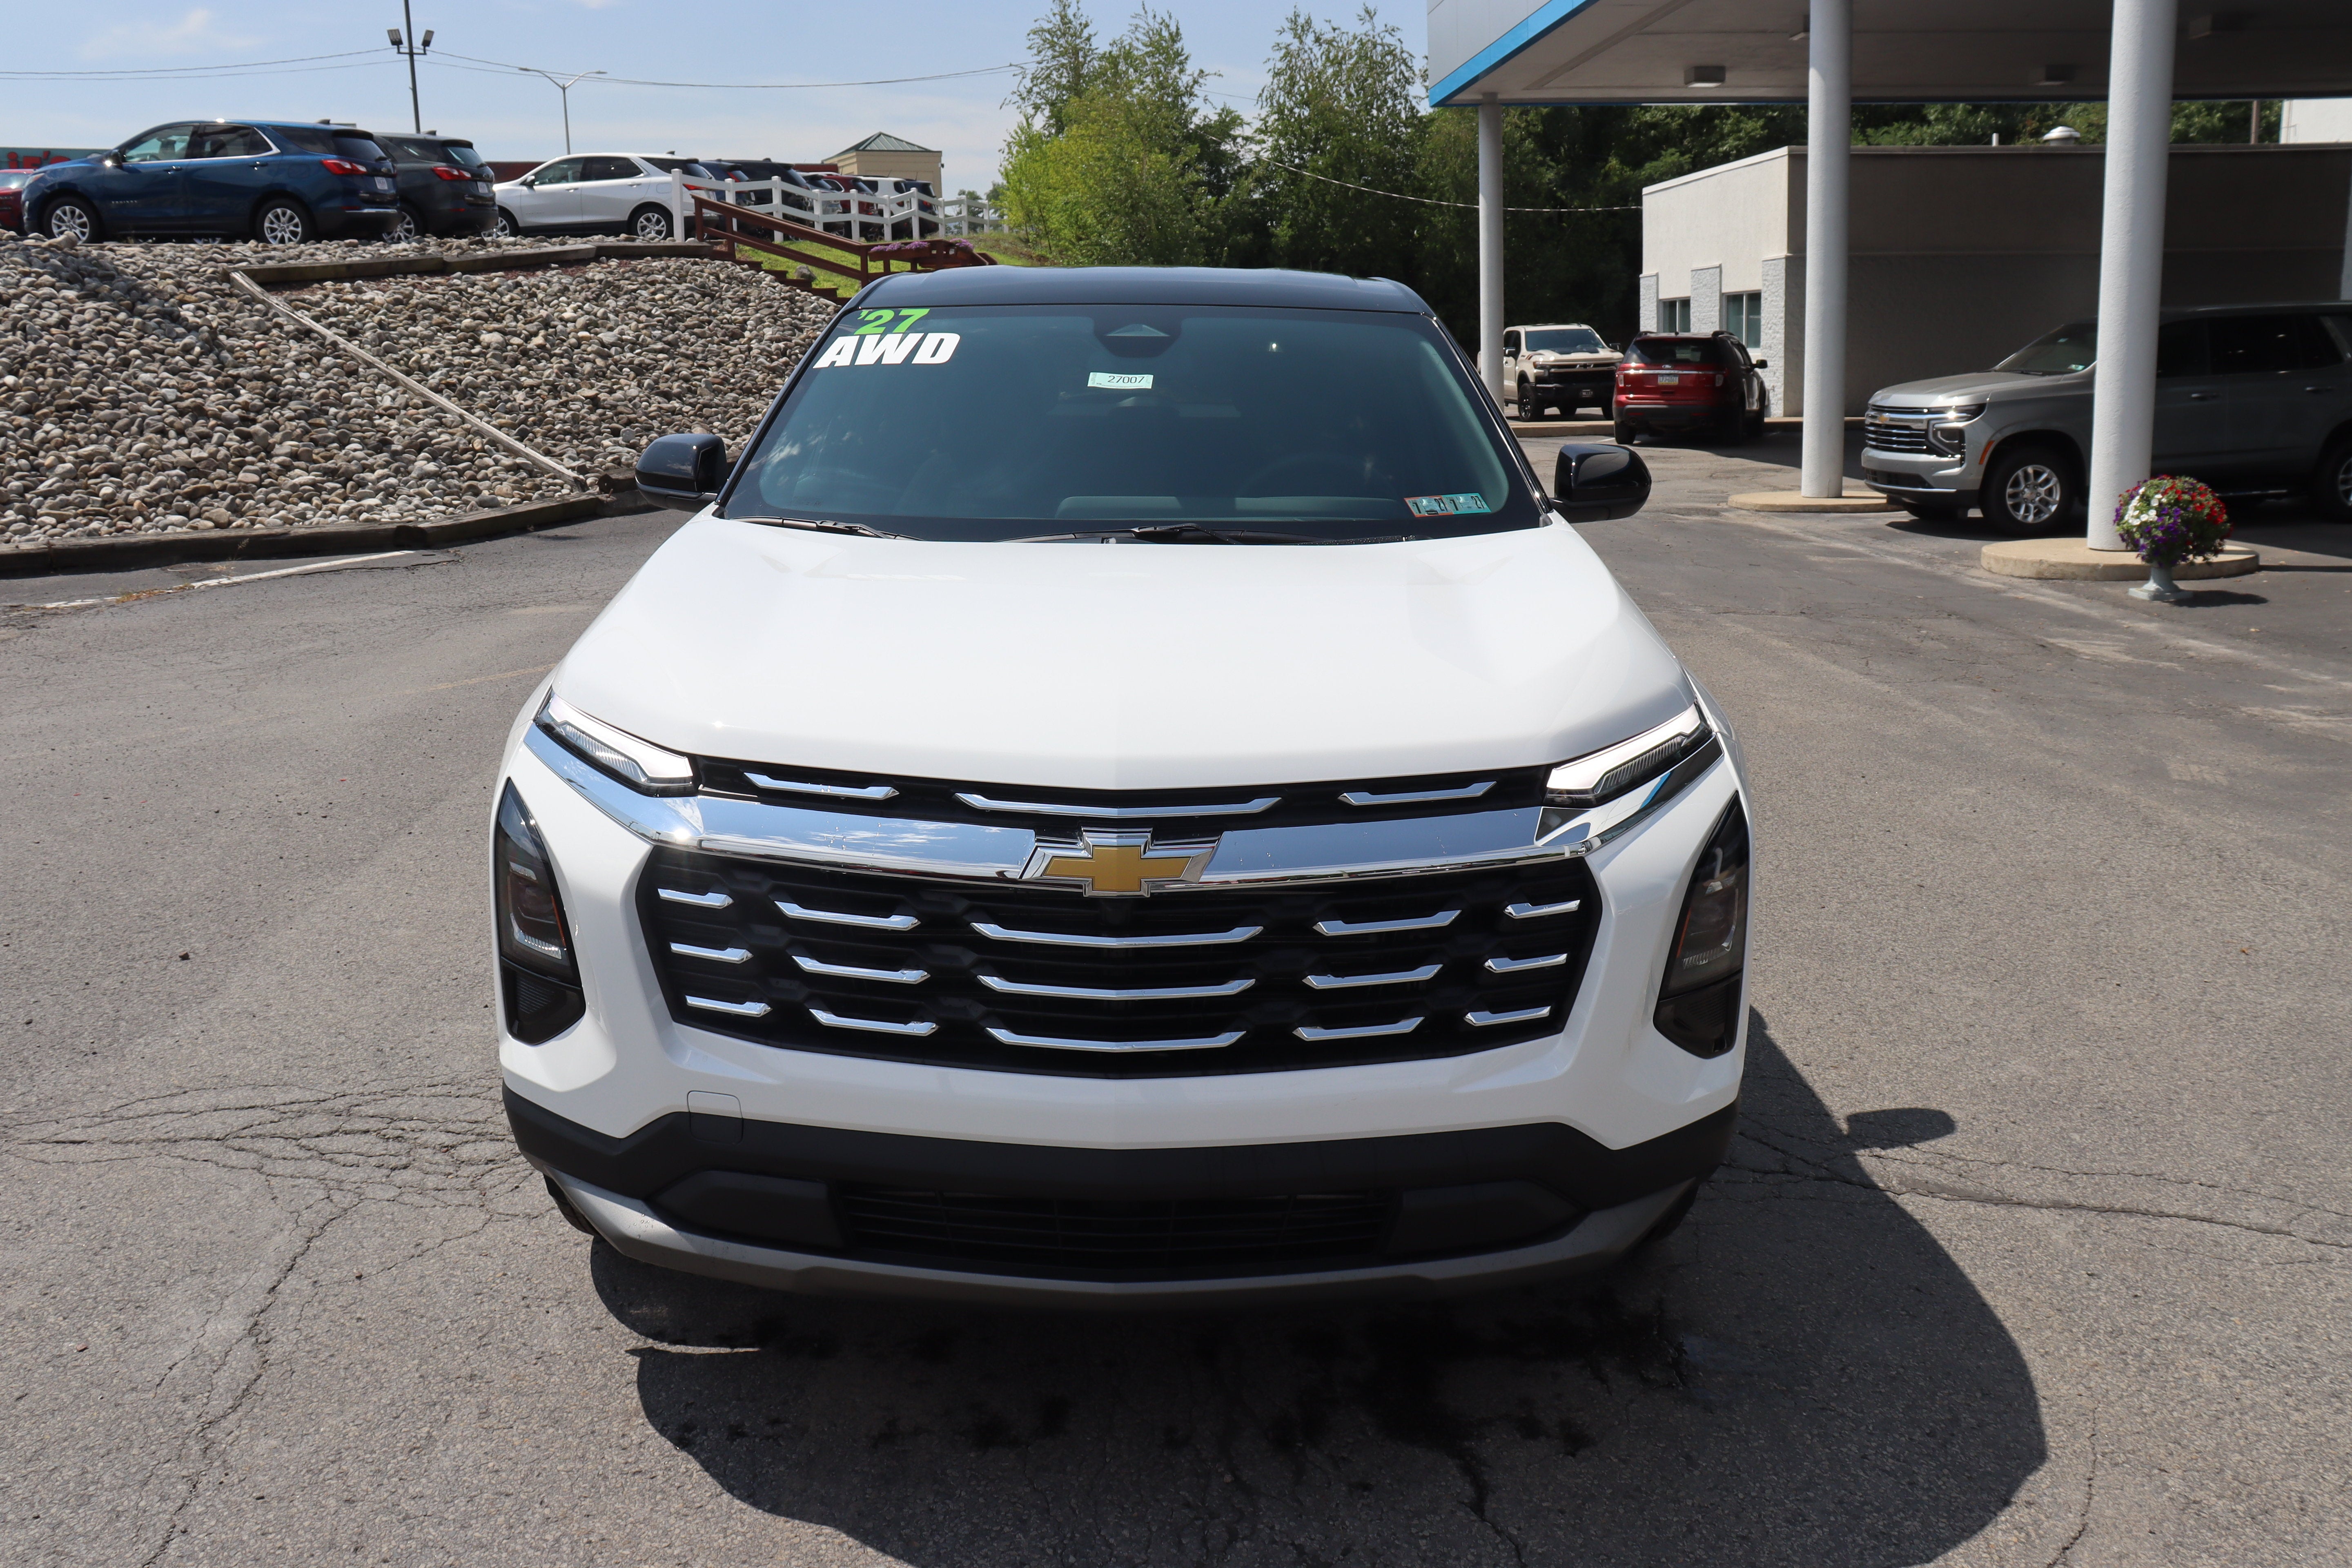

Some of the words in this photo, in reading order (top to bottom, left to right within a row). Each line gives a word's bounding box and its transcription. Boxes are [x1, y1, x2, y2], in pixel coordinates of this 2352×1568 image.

[854, 308, 931, 335] '27
[813, 333, 961, 368] AWD
[1107, 375, 1145, 383] 27007
[1434, 498, 1448, 512] 27
[1470, 495, 1485, 510] 27
